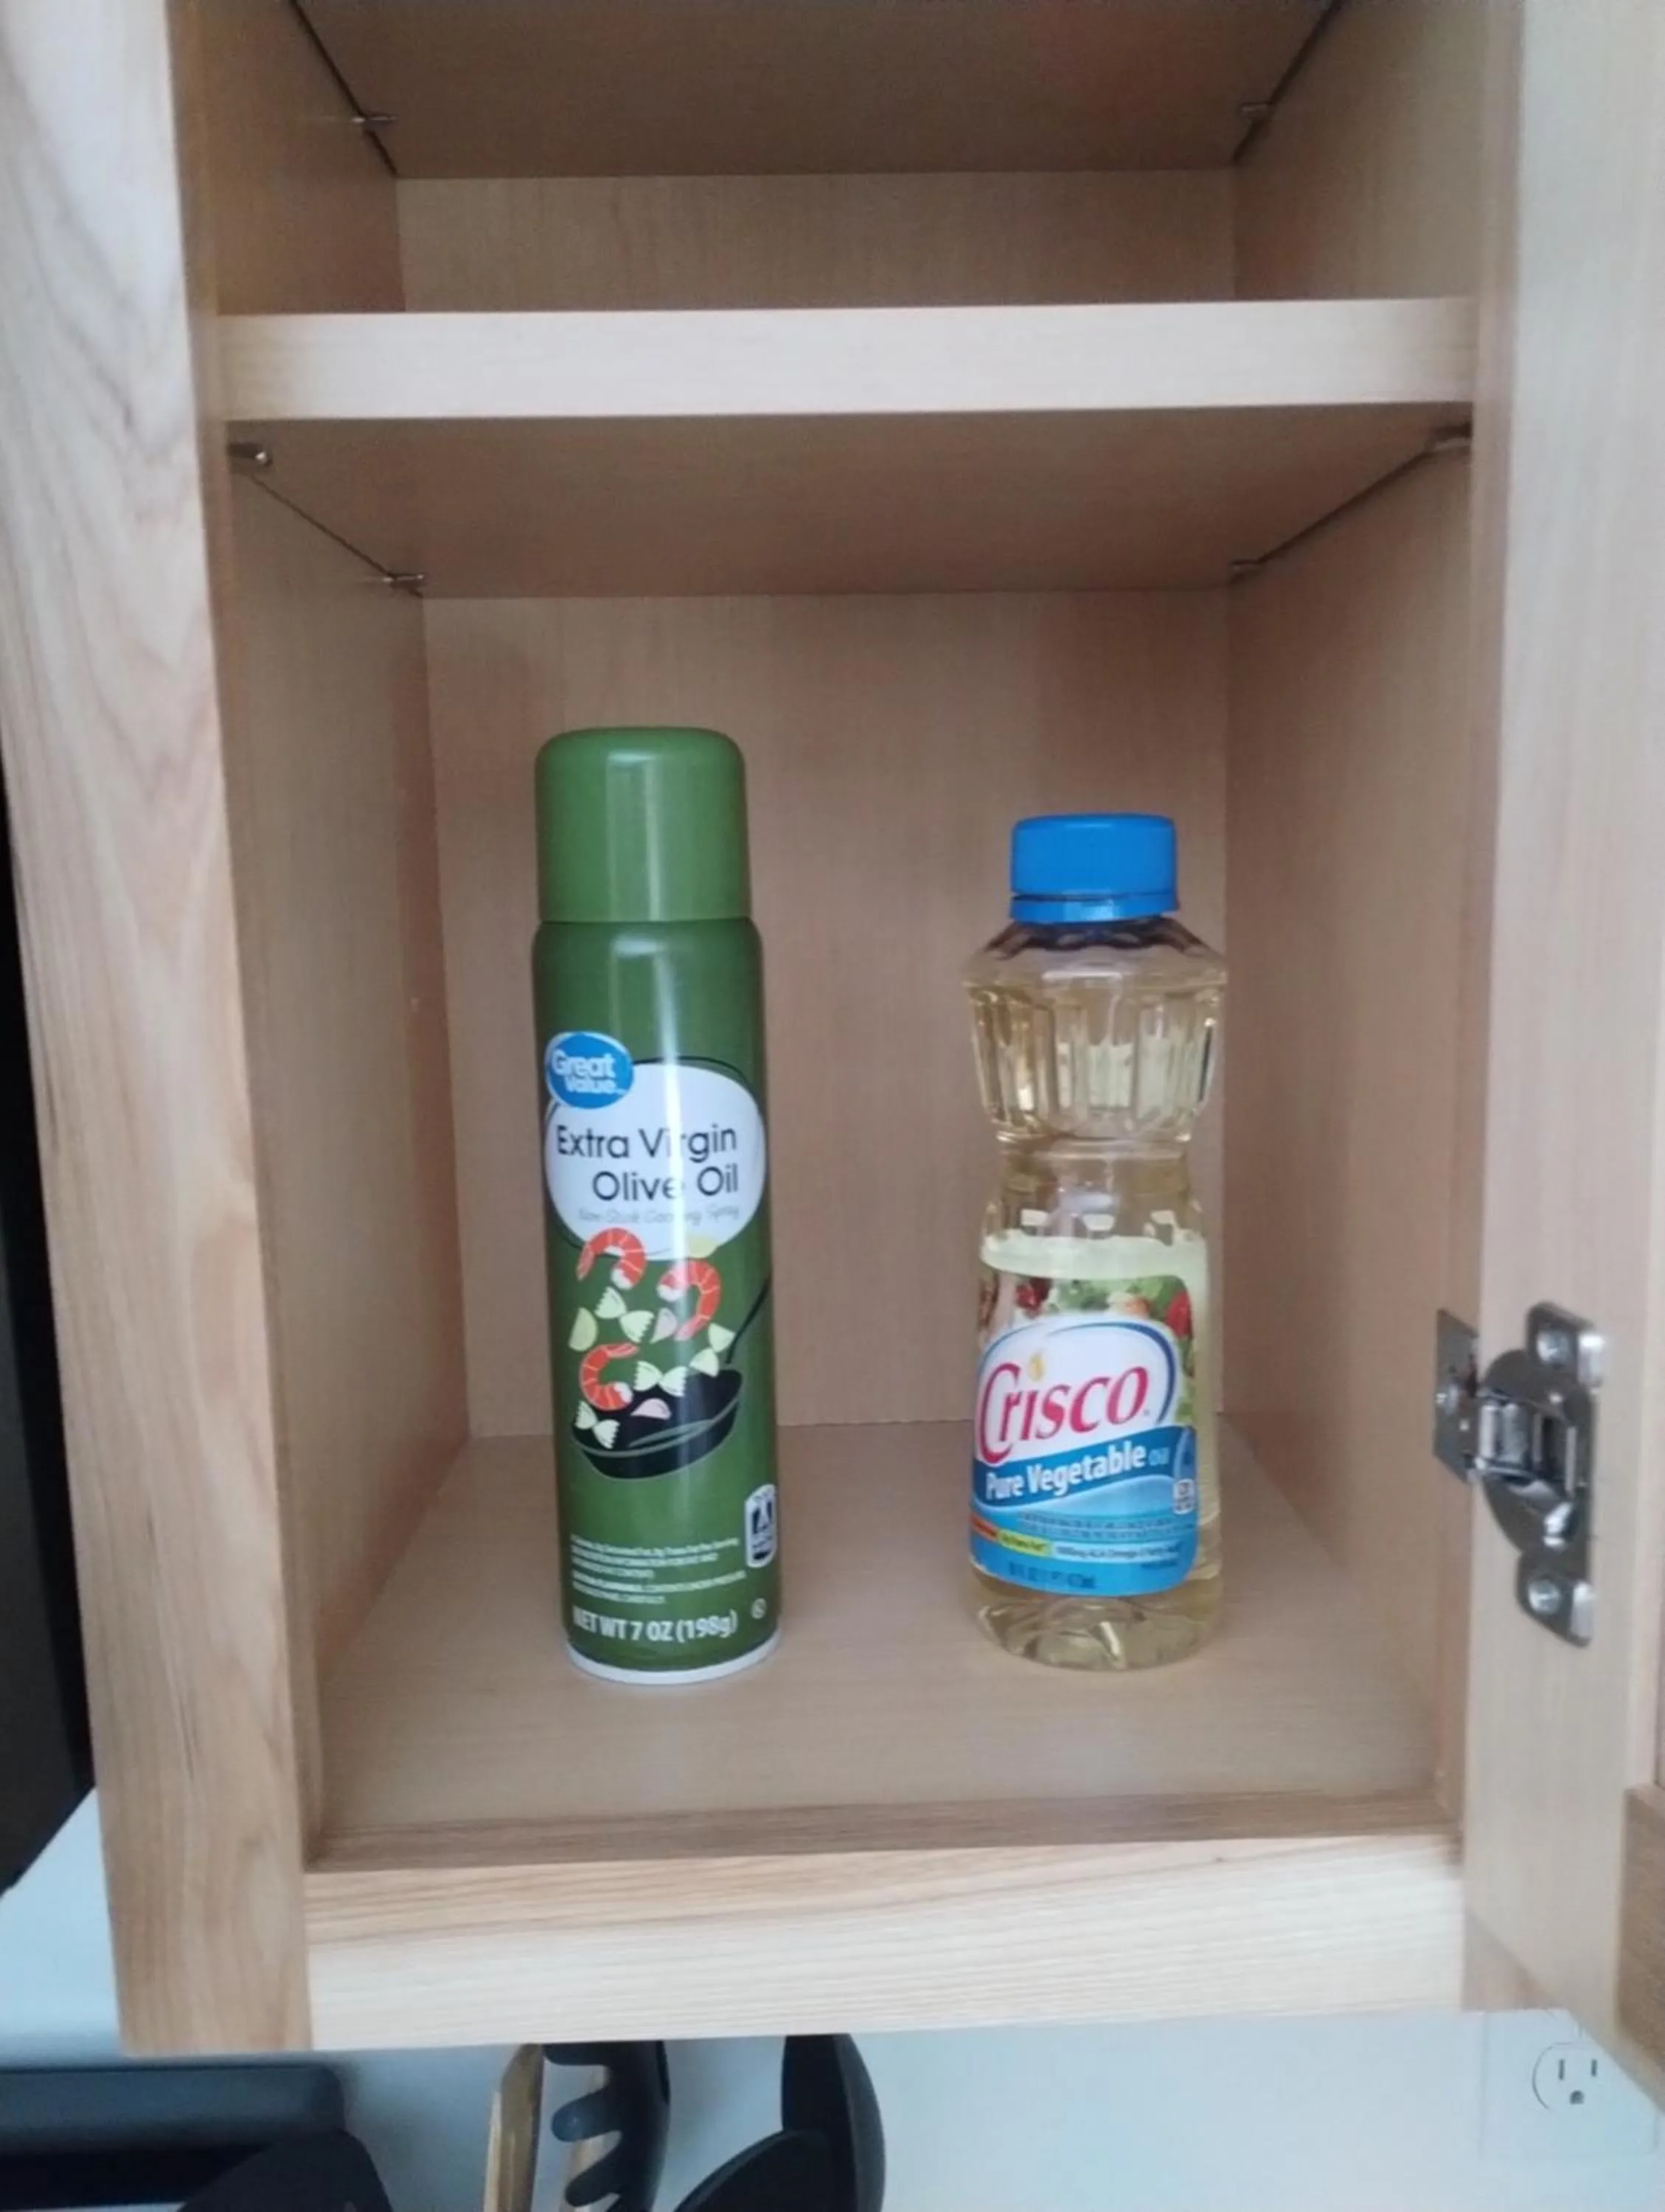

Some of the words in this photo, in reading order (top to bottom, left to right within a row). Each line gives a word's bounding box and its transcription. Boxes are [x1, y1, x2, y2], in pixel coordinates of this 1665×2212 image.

[557, 1125, 629, 1158] Extra
[593, 1172, 685, 1200] Olive
[698, 1164, 738, 1196] Oil
[980, 1357, 1150, 1464] Crisco
[986, 1472, 1024, 1500] Pure
[1026, 1441, 1147, 1495] Vegetable
[572, 1604, 597, 1633] NET
[599, 1615, 626, 1641] WT
[630, 1621, 644, 1641] 7
[646, 1621, 673, 1642] OZ
